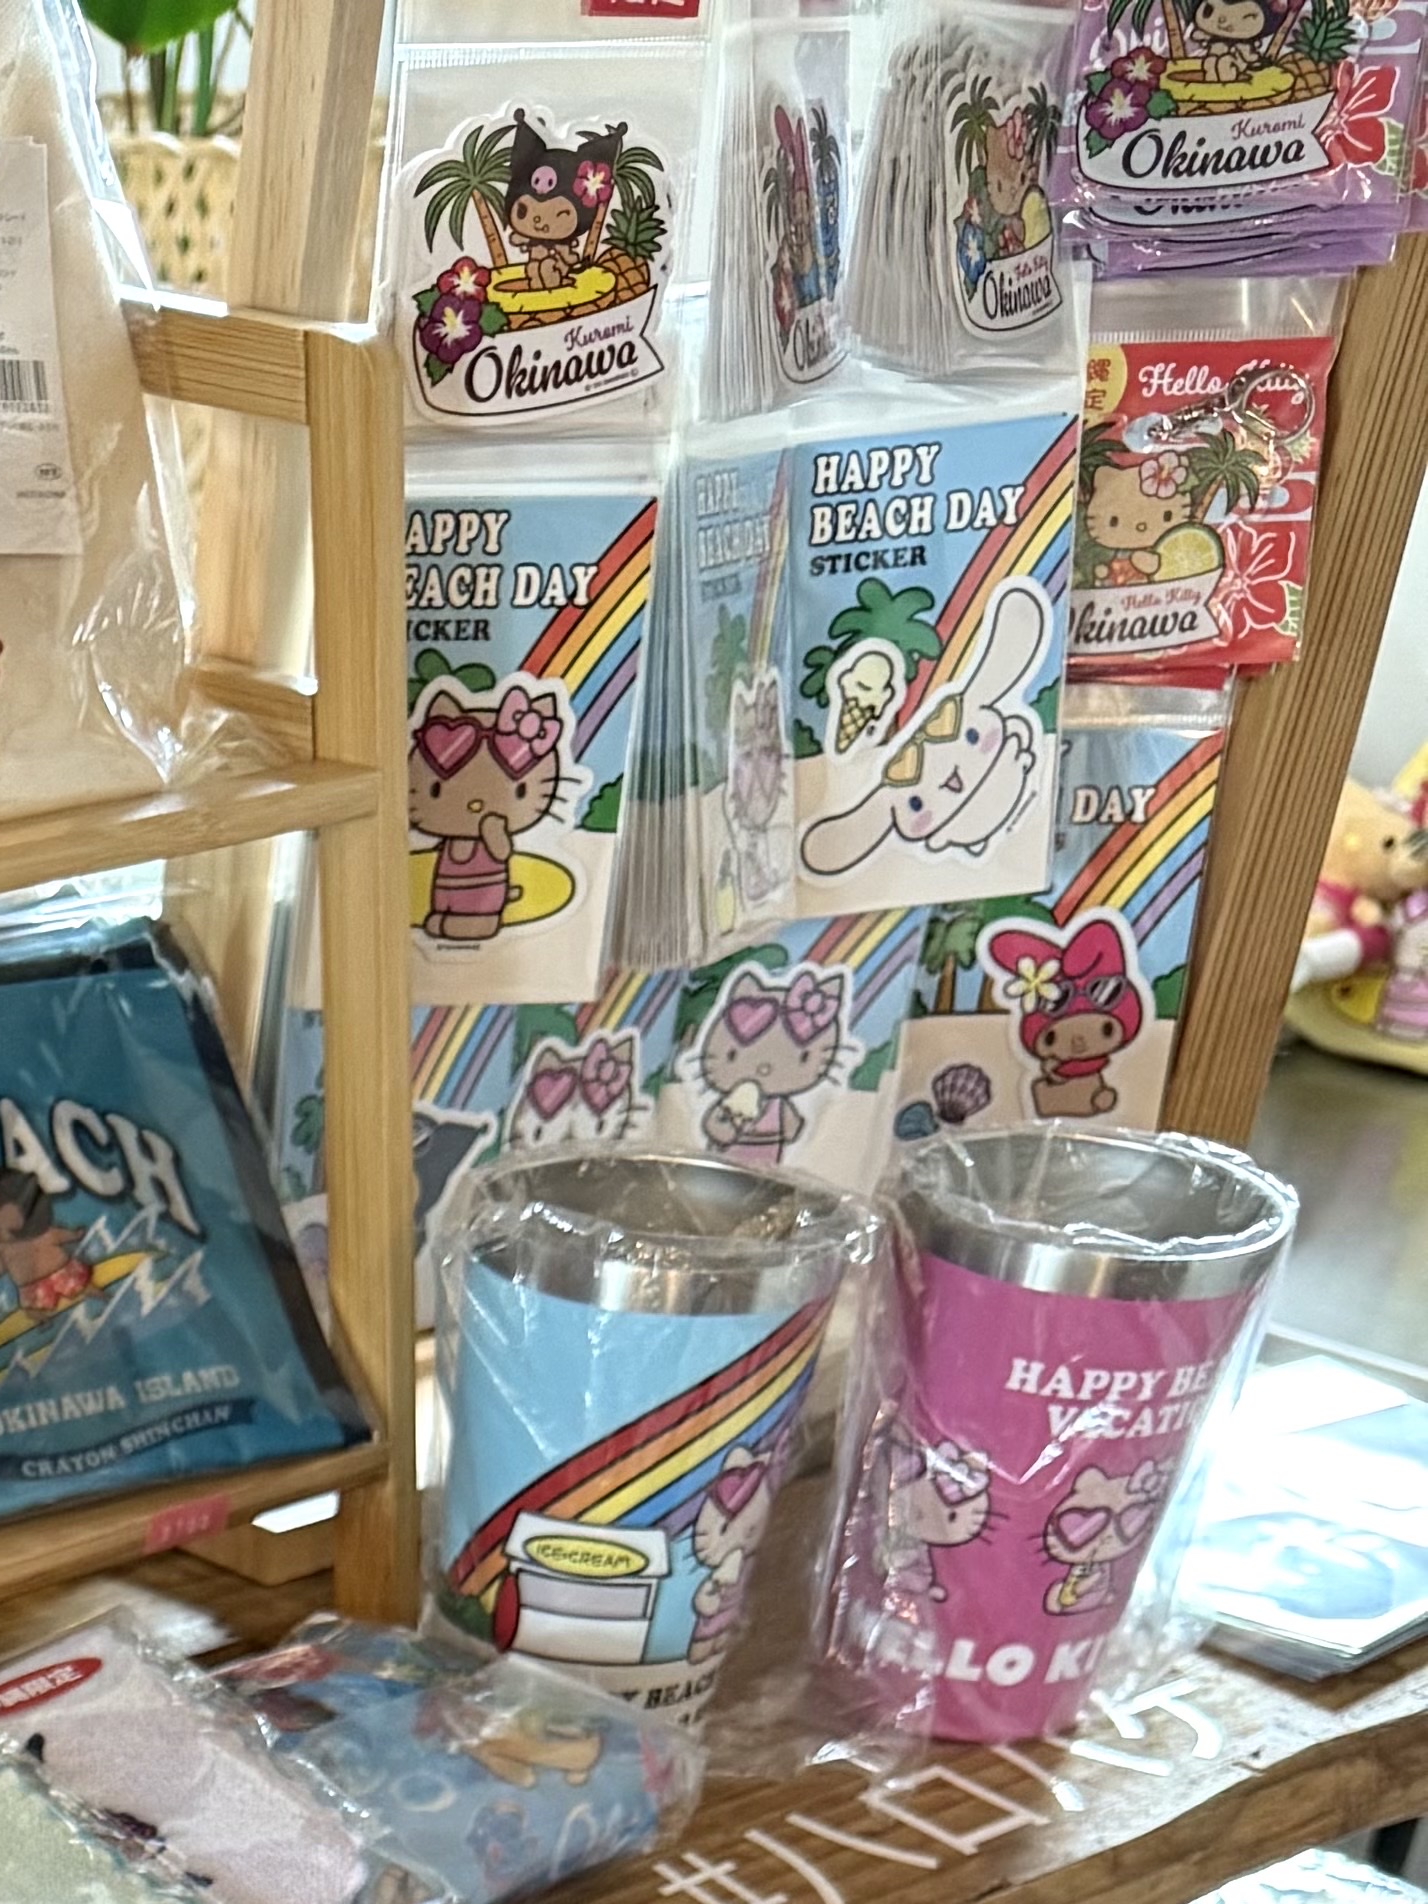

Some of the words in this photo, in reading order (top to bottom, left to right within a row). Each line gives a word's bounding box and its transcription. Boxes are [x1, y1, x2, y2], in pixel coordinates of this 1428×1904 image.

[1231, 118, 1306, 141] Kuromi
[1122, 128, 1306, 179] Okinawa
[982, 270, 1053, 321] Okinawa
[563, 316, 634, 354] Kuromi
[464, 338, 639, 402] Okinawa
[1138, 362, 1223, 398] Hello
[814, 443, 942, 495] HAPPY
[405, 509, 512, 556] APPY
[809, 489, 936, 548] BEACH
[946, 483, 1028, 531] DAY
[808, 544, 928, 577] STICKER
[405, 563, 503, 609] EACH
[511, 563, 599, 609] DAY
[406, 618, 491, 642] ICKER
[1071, 601, 1199, 646] kinawa
[1070, 783, 1157, 825] DAY
[1004, 1356, 1164, 1402] HAPPY
[1171, 1360, 1215, 1398] BE
[1044, 1635, 1105, 1684] KI
